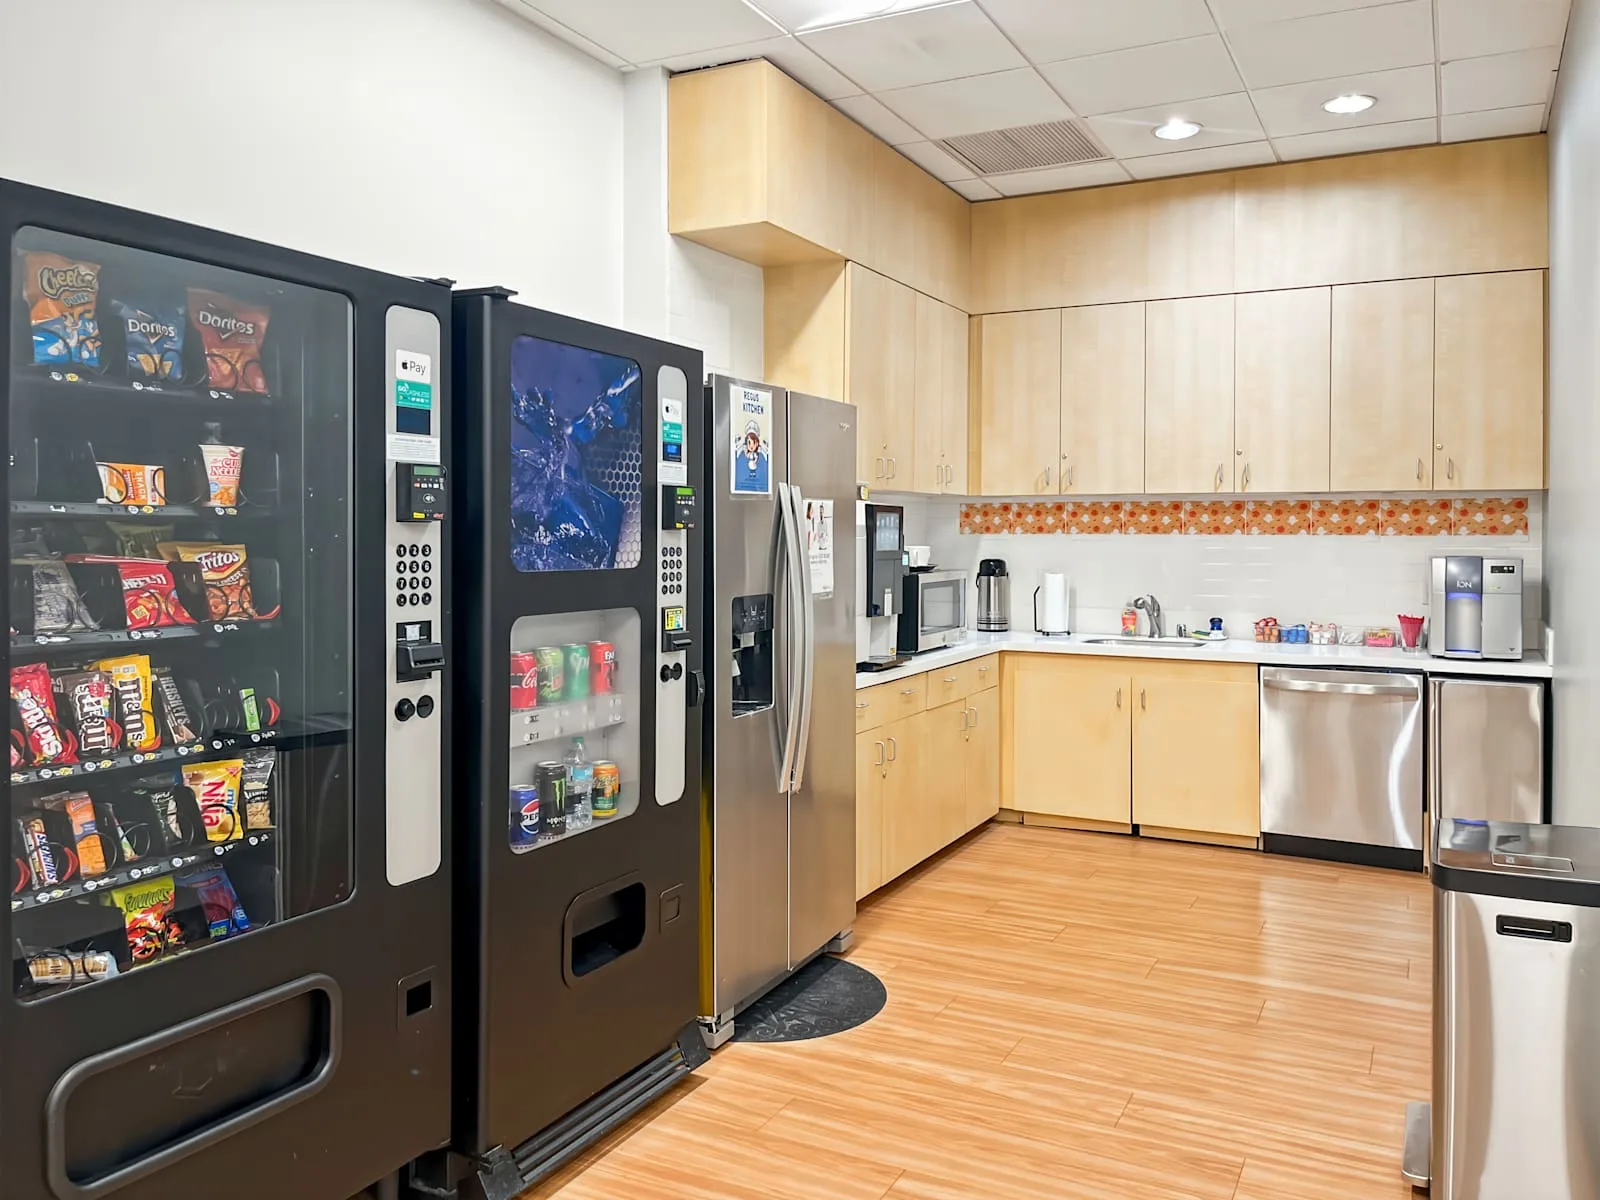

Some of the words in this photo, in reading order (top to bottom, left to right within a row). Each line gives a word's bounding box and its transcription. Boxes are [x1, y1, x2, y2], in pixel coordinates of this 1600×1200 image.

[128, 318, 175, 338] Doritos
[200, 311, 255, 335] Doritos
[409, 361, 426, 376] Pay
[743, 402, 764, 415] KITCHEN
[196, 552, 239, 572] Fritos
[1456, 580, 1472, 589] ION
